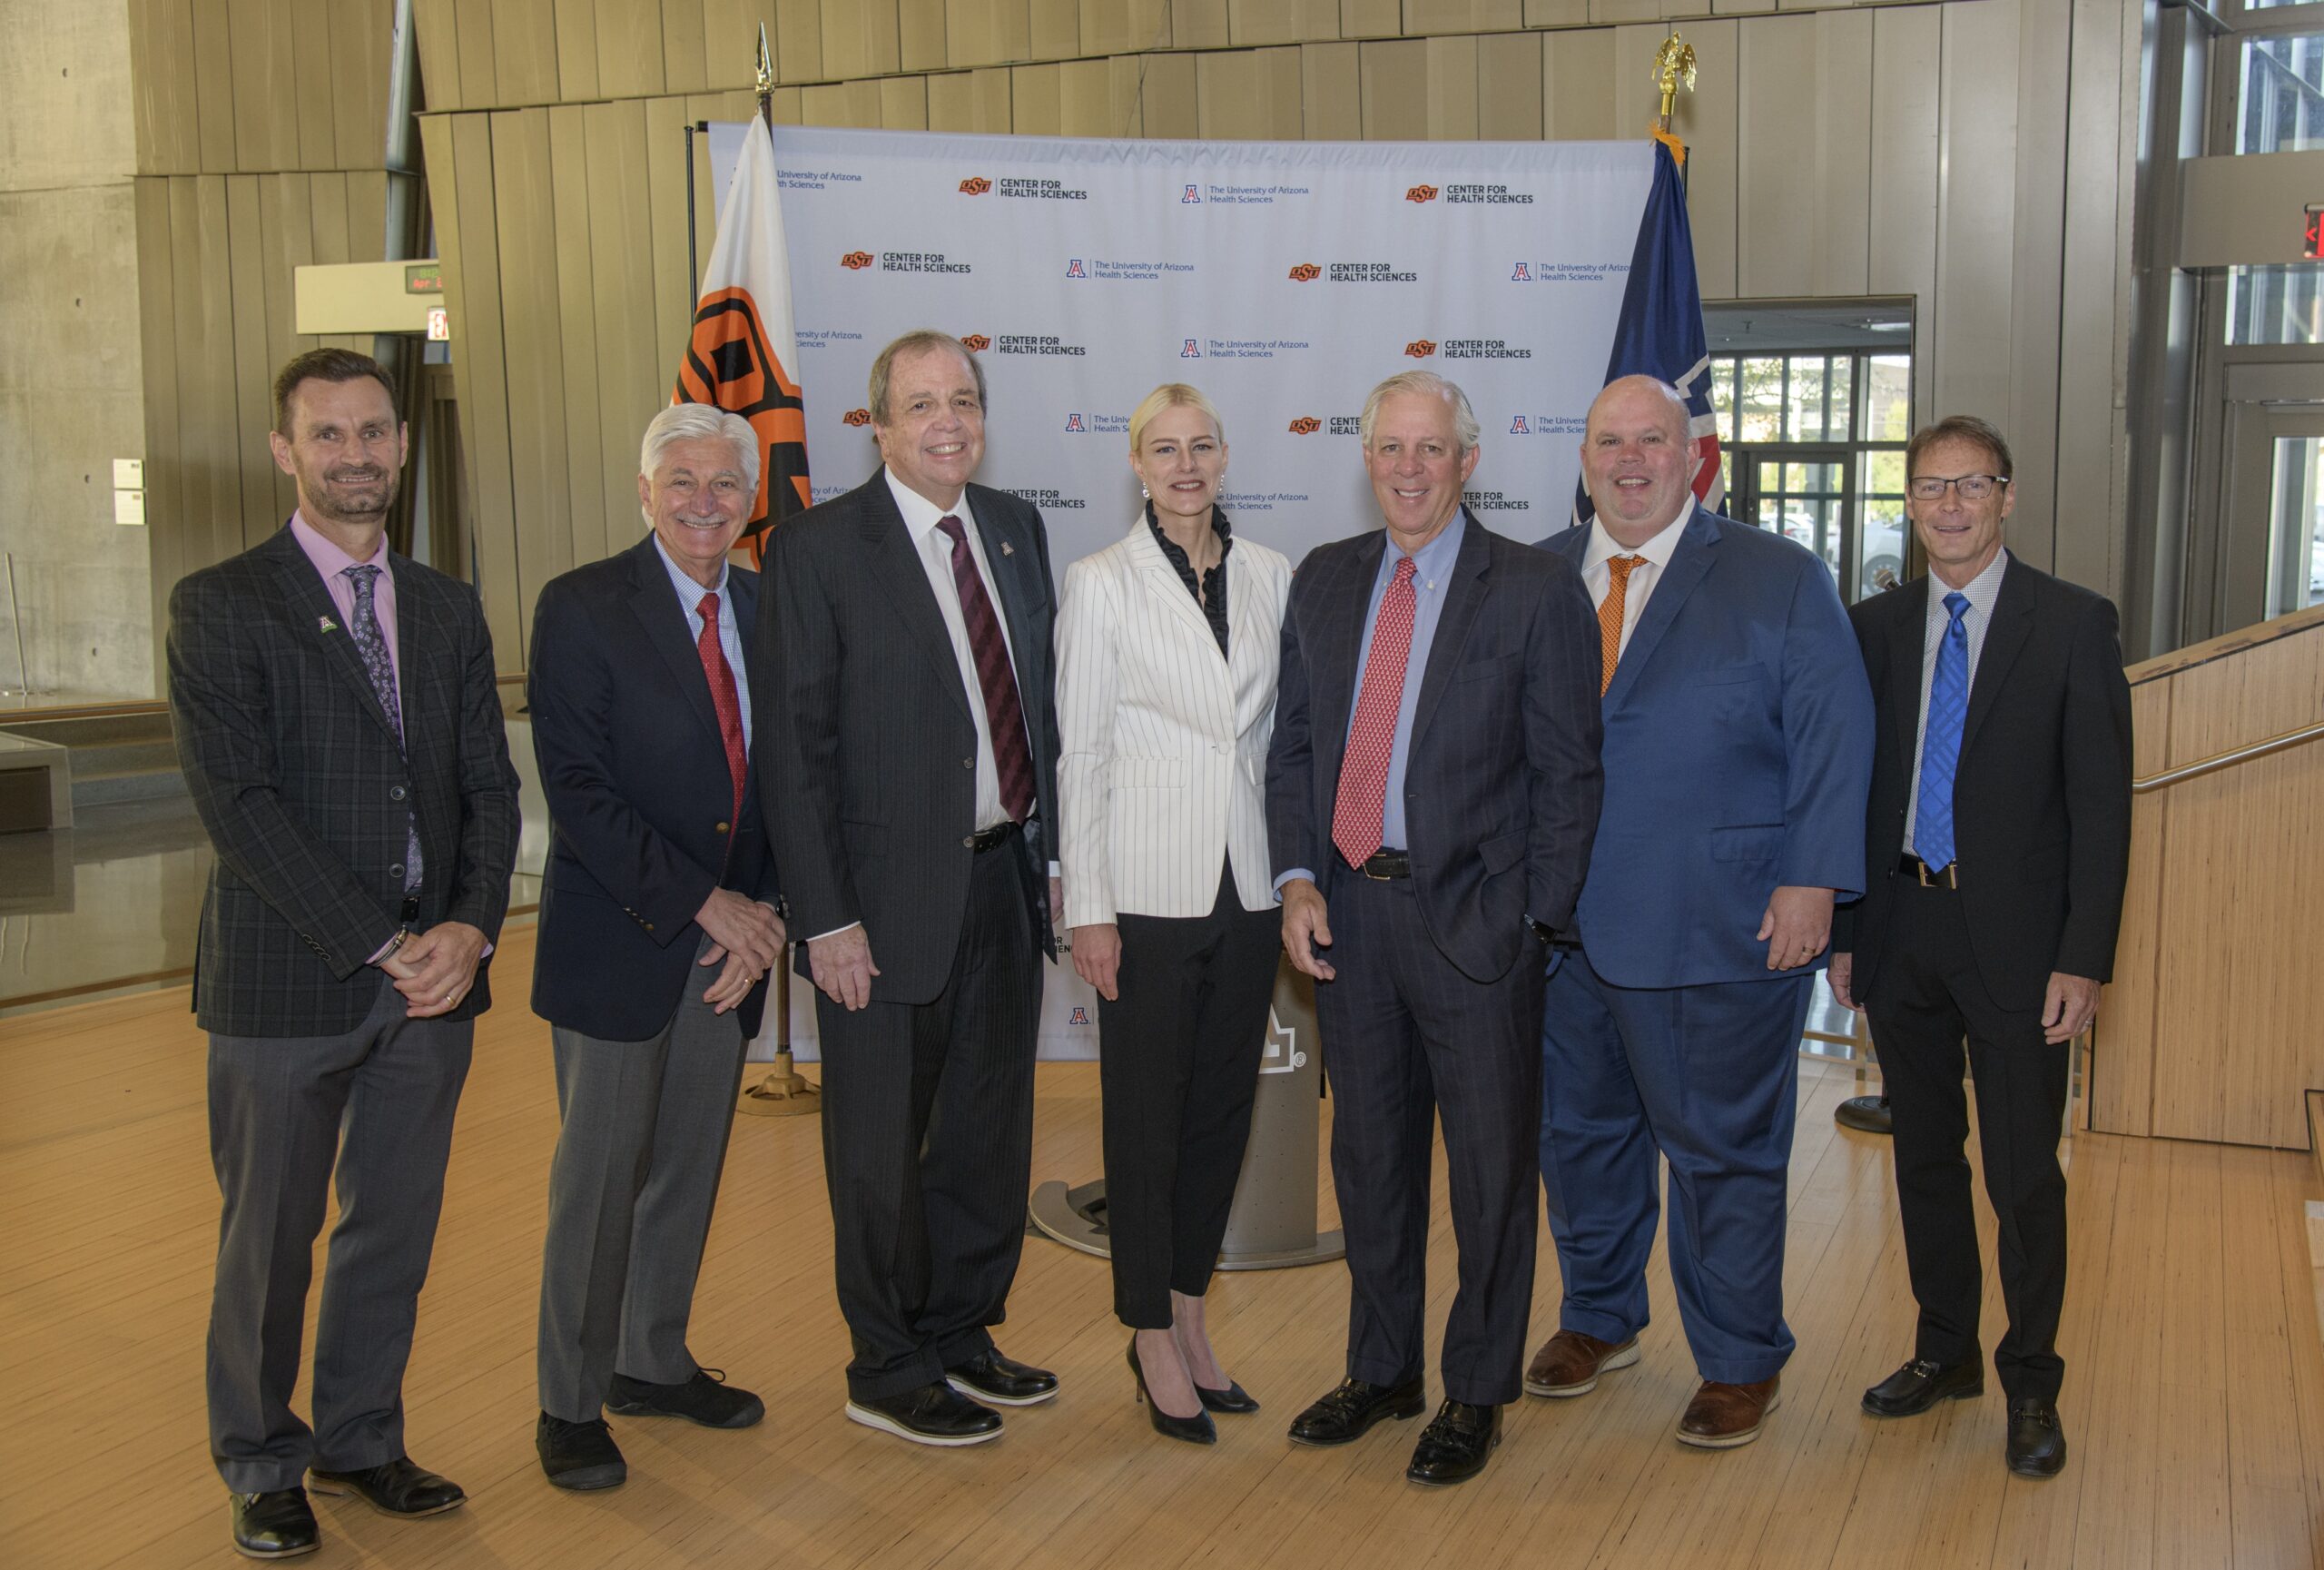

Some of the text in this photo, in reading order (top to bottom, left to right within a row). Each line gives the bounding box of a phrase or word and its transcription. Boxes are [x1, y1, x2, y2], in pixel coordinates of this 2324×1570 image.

[777, 171, 817, 181] University
[832, 173, 862, 181] Arizona
[789, 181, 824, 189] Sciences
[1000, 178, 1060, 189] CENTER FOR
[1227, 186, 1266, 195] University
[1268, 185, 1276, 193] of
[1447, 185, 1507, 193] CENTER FOR
[1000, 188, 1087, 200] HEALTH SCIENCES
[1447, 194, 1533, 203] HEALTH SCIENCES
[883, 252, 944, 263] CENTER FOR
[883, 262, 970, 273] HEALTH SCIENCES
[1112, 262, 1152, 272] University
[1330, 263, 1391, 272] CENTER FOR
[1541, 263, 1555, 272] The
[1557, 263, 1597, 272] University
[1599, 263, 1606, 272] of
[1095, 271, 1121, 279] Health
[1330, 273, 1417, 281] HEALTH SCIENCES
[821, 331, 829, 339] of
[1000, 336, 1059, 345] CENTER FOR
[1445, 341, 1504, 349] CENTER FOR
[1000, 345, 1086, 355] HEALTH SCIENCES
[1226, 341, 1266, 350] University
[1238, 350, 1273, 358] Sciences
[1445, 350, 1531, 358] HEALTH SCIENCES
[1094, 415, 1108, 423] The
[1330, 417, 1362, 426] CENTE
[1330, 426, 1361, 435] HEALT
[1040, 489, 1059, 499] FOR
[1226, 494, 1266, 502] University
[1483, 492, 1502, 500] FOR
[1039, 499, 1085, 509] SCIENCES
[1483, 501, 1529, 509] SCIENCES
